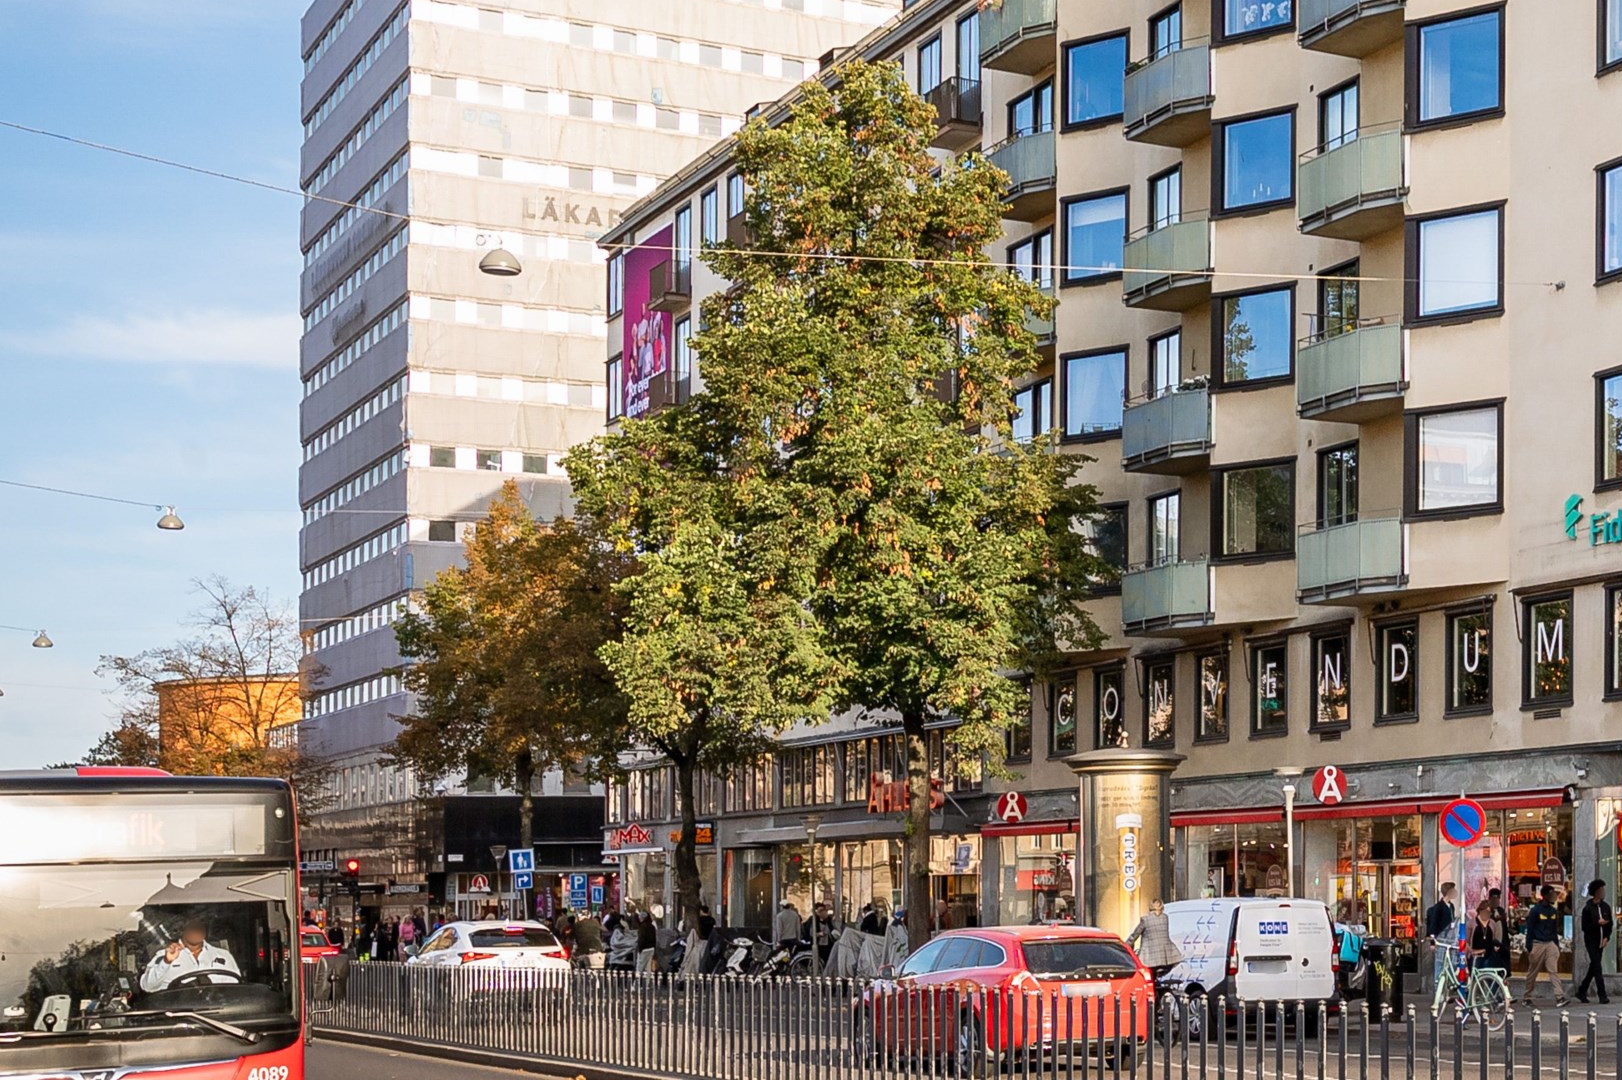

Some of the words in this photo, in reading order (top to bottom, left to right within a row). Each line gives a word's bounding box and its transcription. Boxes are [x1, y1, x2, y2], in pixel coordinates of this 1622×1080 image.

[1319, 765, 1343, 802] Å
[1002, 791, 1023, 821] Å
[619, 822, 652, 844] MAX
[1123, 835, 1136, 890] TREO
[574, 876, 584, 889] P
[1259, 922, 1288, 934] KONE
[248, 1065, 289, 1080] 4089
